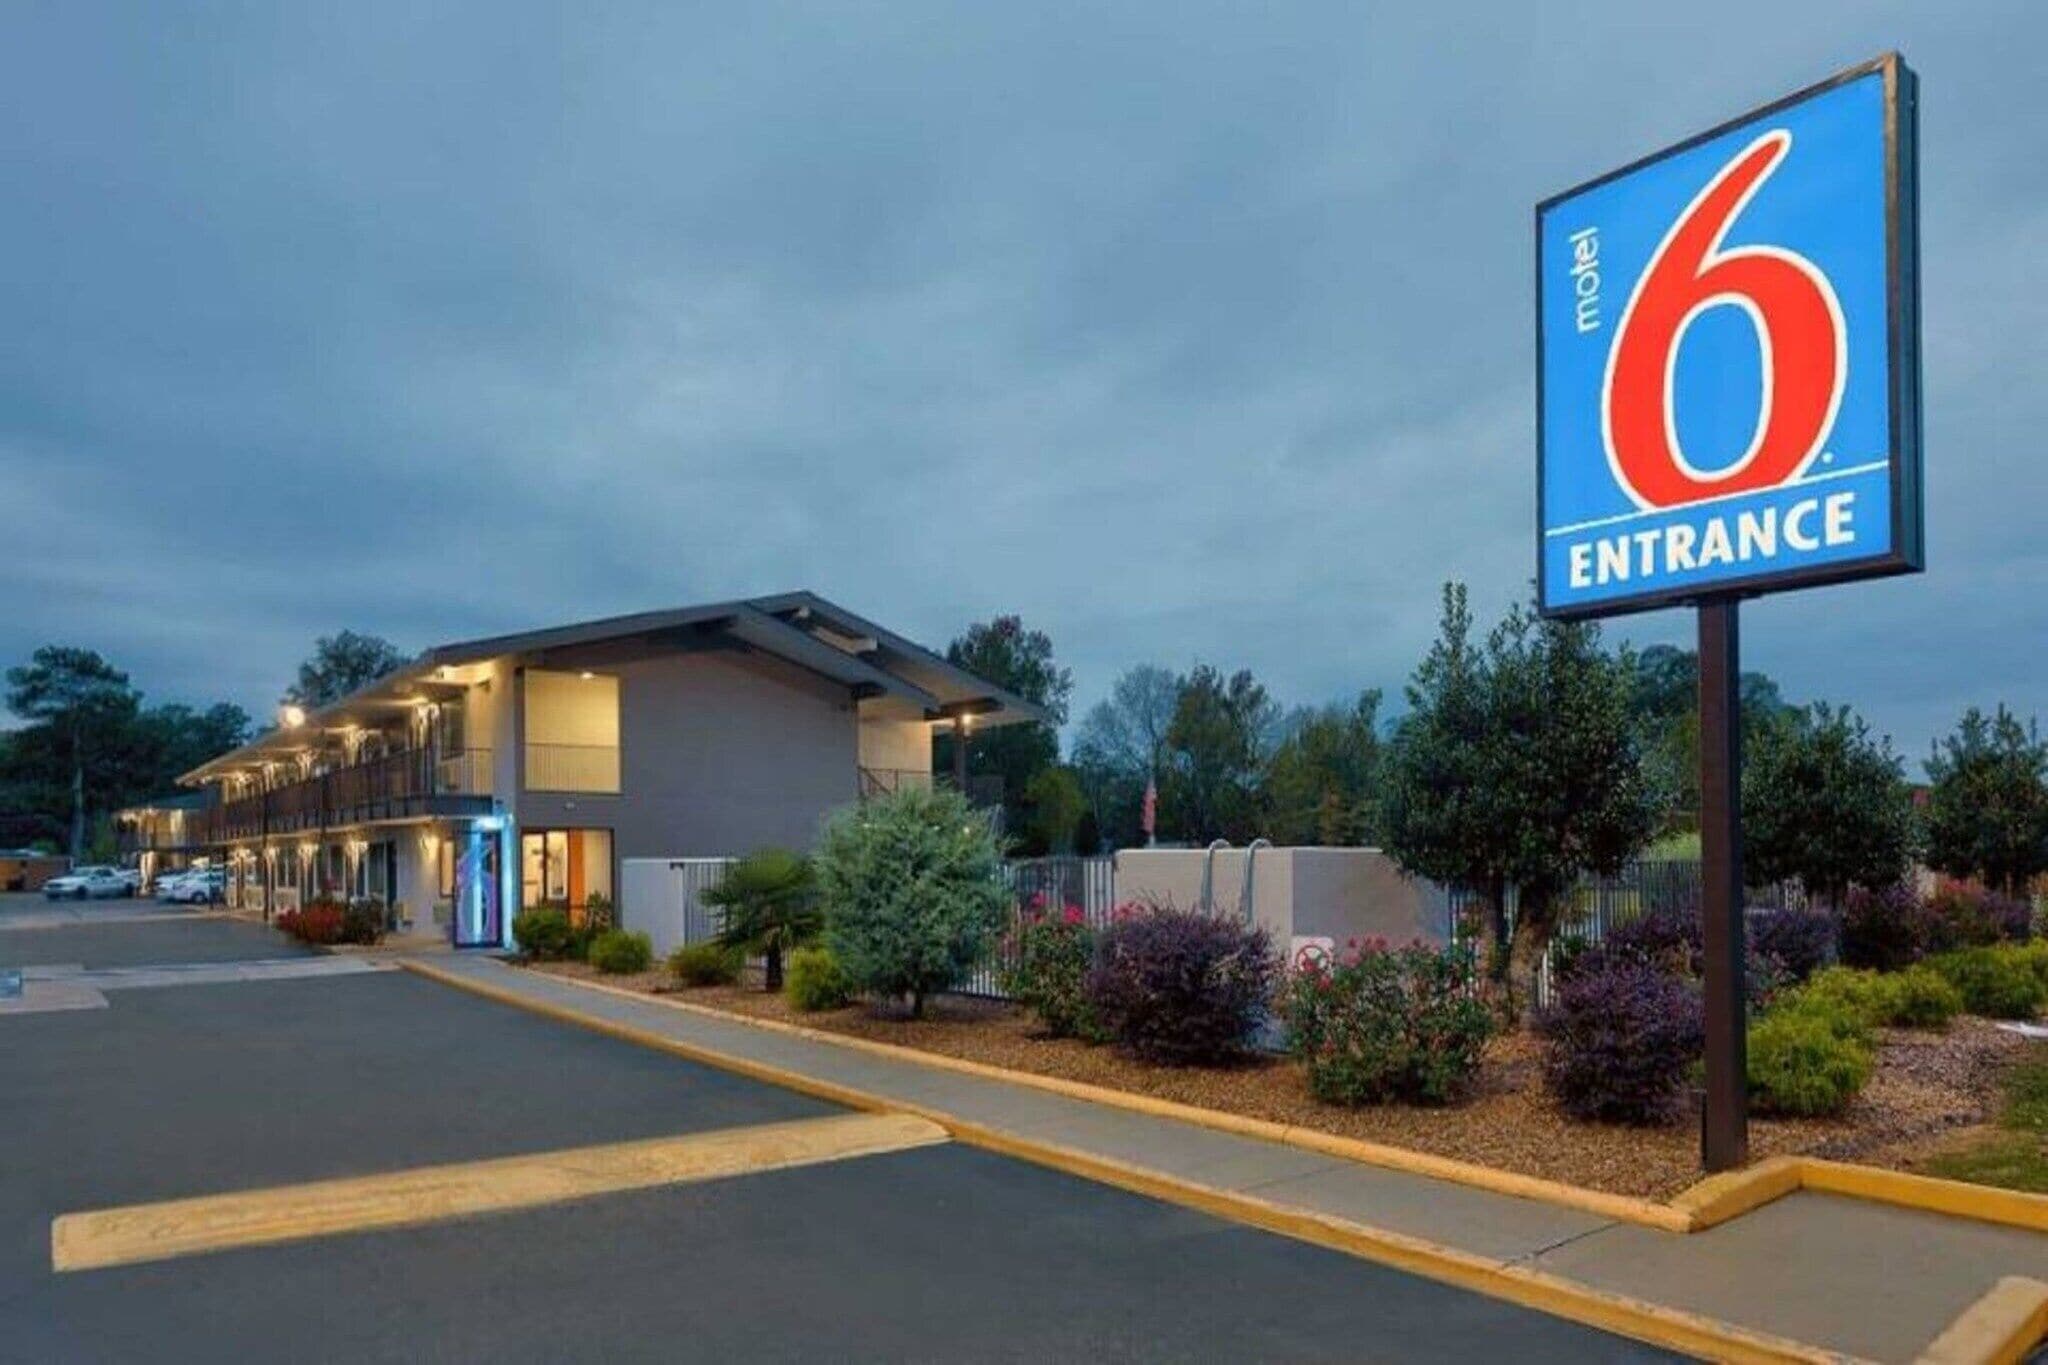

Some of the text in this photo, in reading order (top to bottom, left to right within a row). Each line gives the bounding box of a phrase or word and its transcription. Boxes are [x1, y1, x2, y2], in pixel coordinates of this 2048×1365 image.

[1569, 226, 1601, 332] motel
[1601, 128, 1847, 512] 6
[1569, 492, 1855, 588] ENTRANCE
